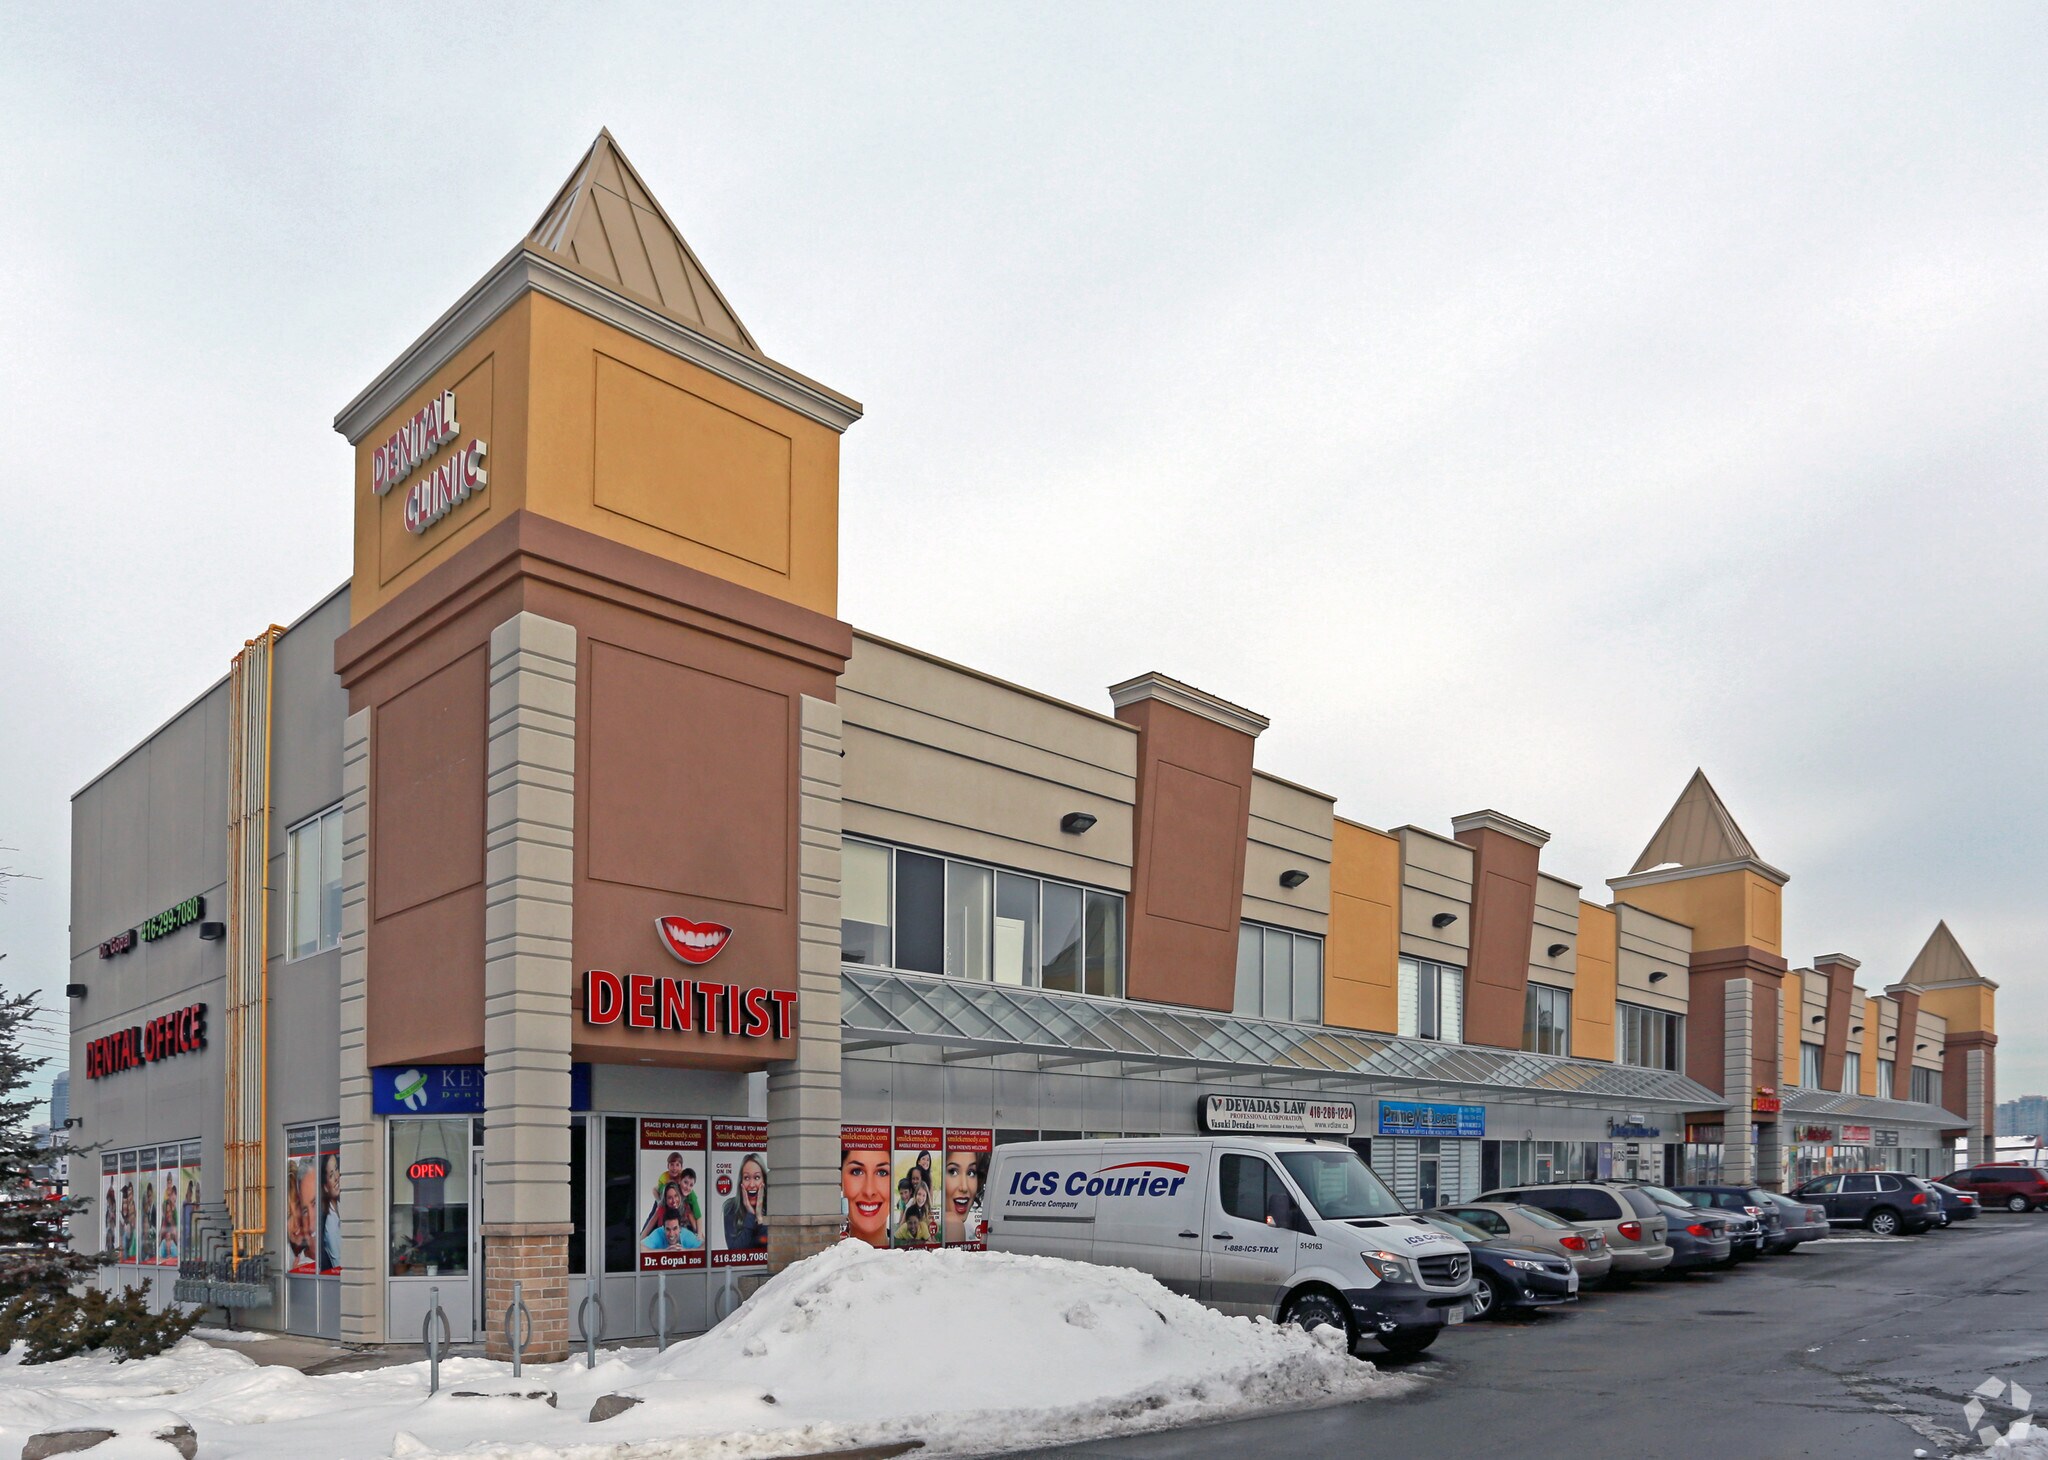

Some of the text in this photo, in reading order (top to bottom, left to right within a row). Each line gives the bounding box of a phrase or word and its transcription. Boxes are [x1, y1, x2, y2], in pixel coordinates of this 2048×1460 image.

[373, 389, 459, 496] DENTAL
[404, 439, 486, 534] CLINIC
[140, 896, 199, 941] 416-299-7080
[588, 969, 798, 1040] DENTIST
[144, 1003, 202, 1062] OFFICE
[87, 1026, 141, 1080] DENTAL
[1225, 1098, 1280, 1114] DEVADAS
[1284, 1101, 1306, 1115] LAW
[1211, 1119, 1255, 1130] Vasuki Devadas
[410, 1163, 444, 1179] OPEN
[1009, 1170, 1186, 1197] ICS Courier
[1012, 1200, 1046, 1208] TransForce
[1047, 1200, 1078, 1209] Company
[1300, 1242, 1323, 1250] 51-0163
[1404, 1235, 1424, 1245] ICS
[1224, 1245, 1279, 1253] 1-888-ICS-TRAX
[645, 1256, 658, 1267] Dr.
[661, 1255, 686, 1267] Gopal
